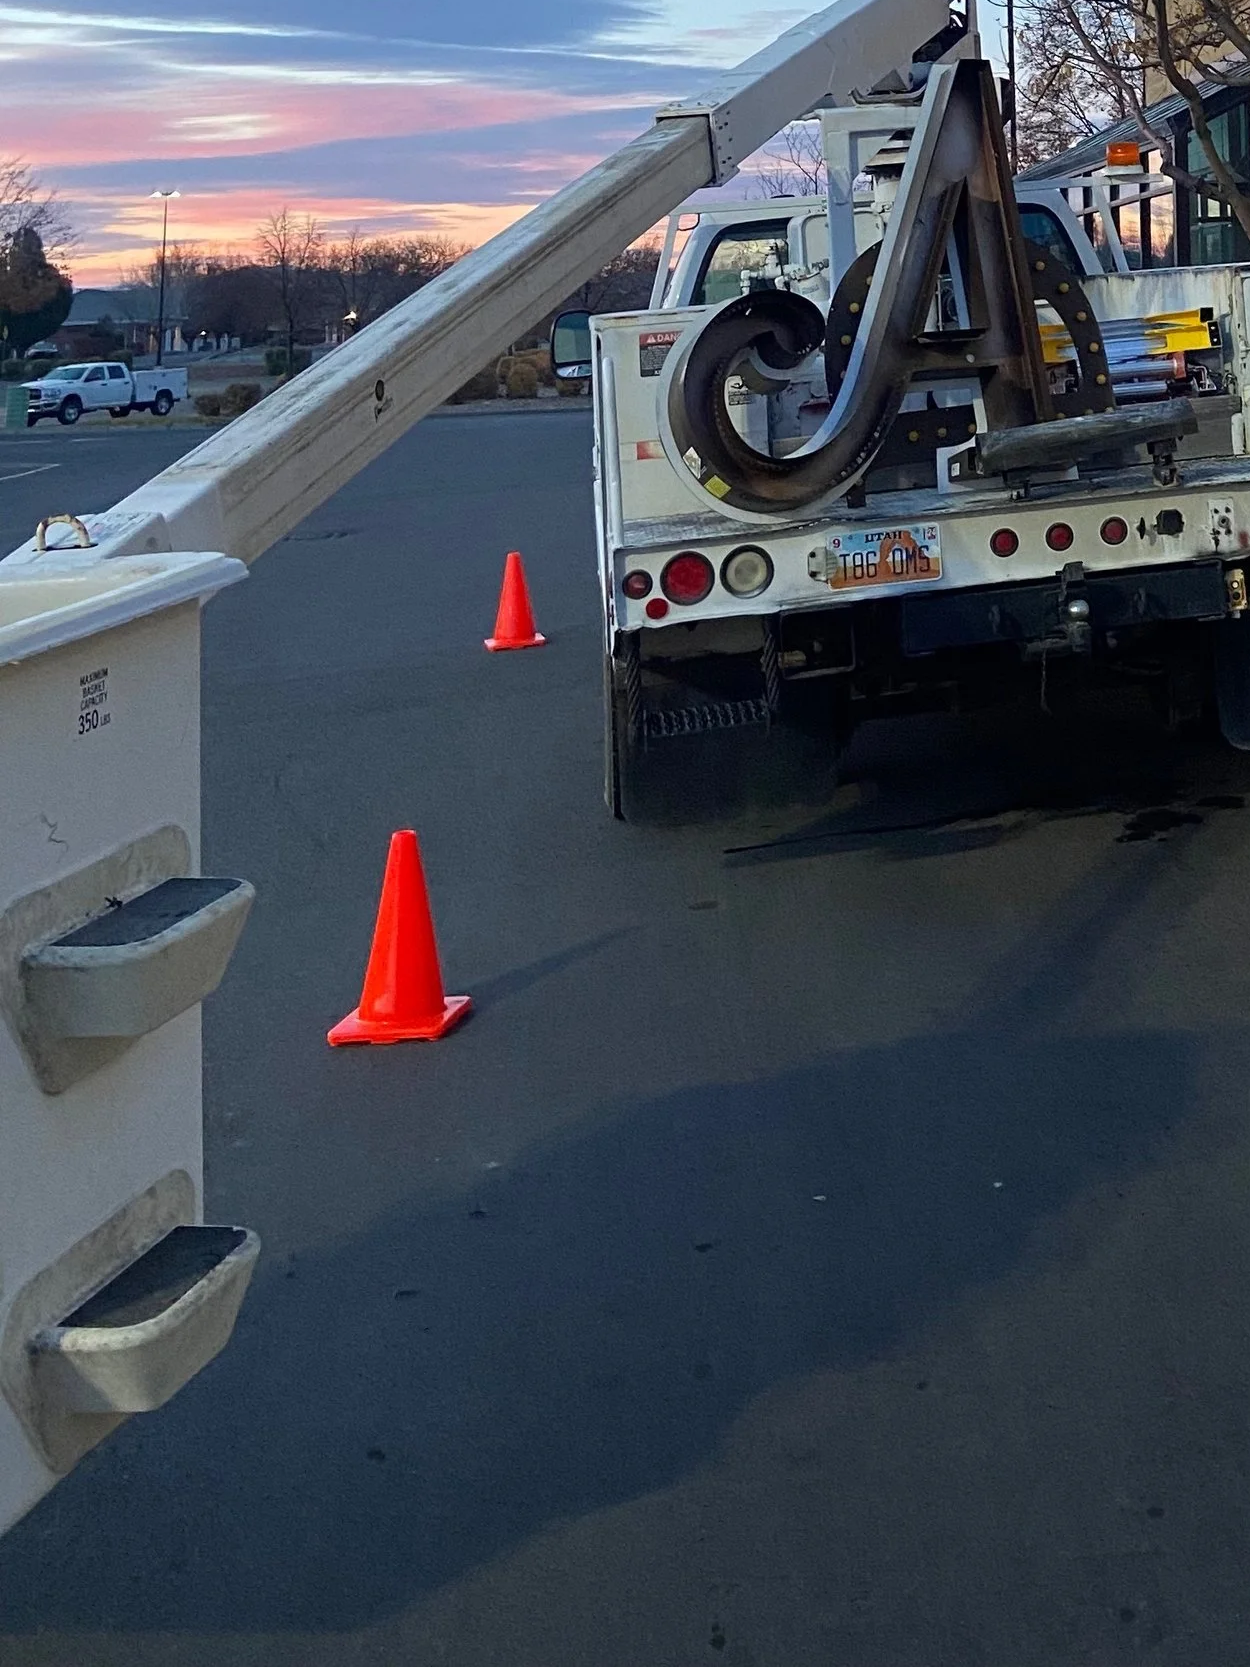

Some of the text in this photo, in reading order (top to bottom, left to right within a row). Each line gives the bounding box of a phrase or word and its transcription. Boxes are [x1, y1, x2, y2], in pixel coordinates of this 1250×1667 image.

[657, 333, 680, 342] DAN
[832, 538, 841, 548] 9
[865, 531, 902, 543] UTAH
[839, 551, 877, 581] T86
[78, 709, 99, 734] 350
